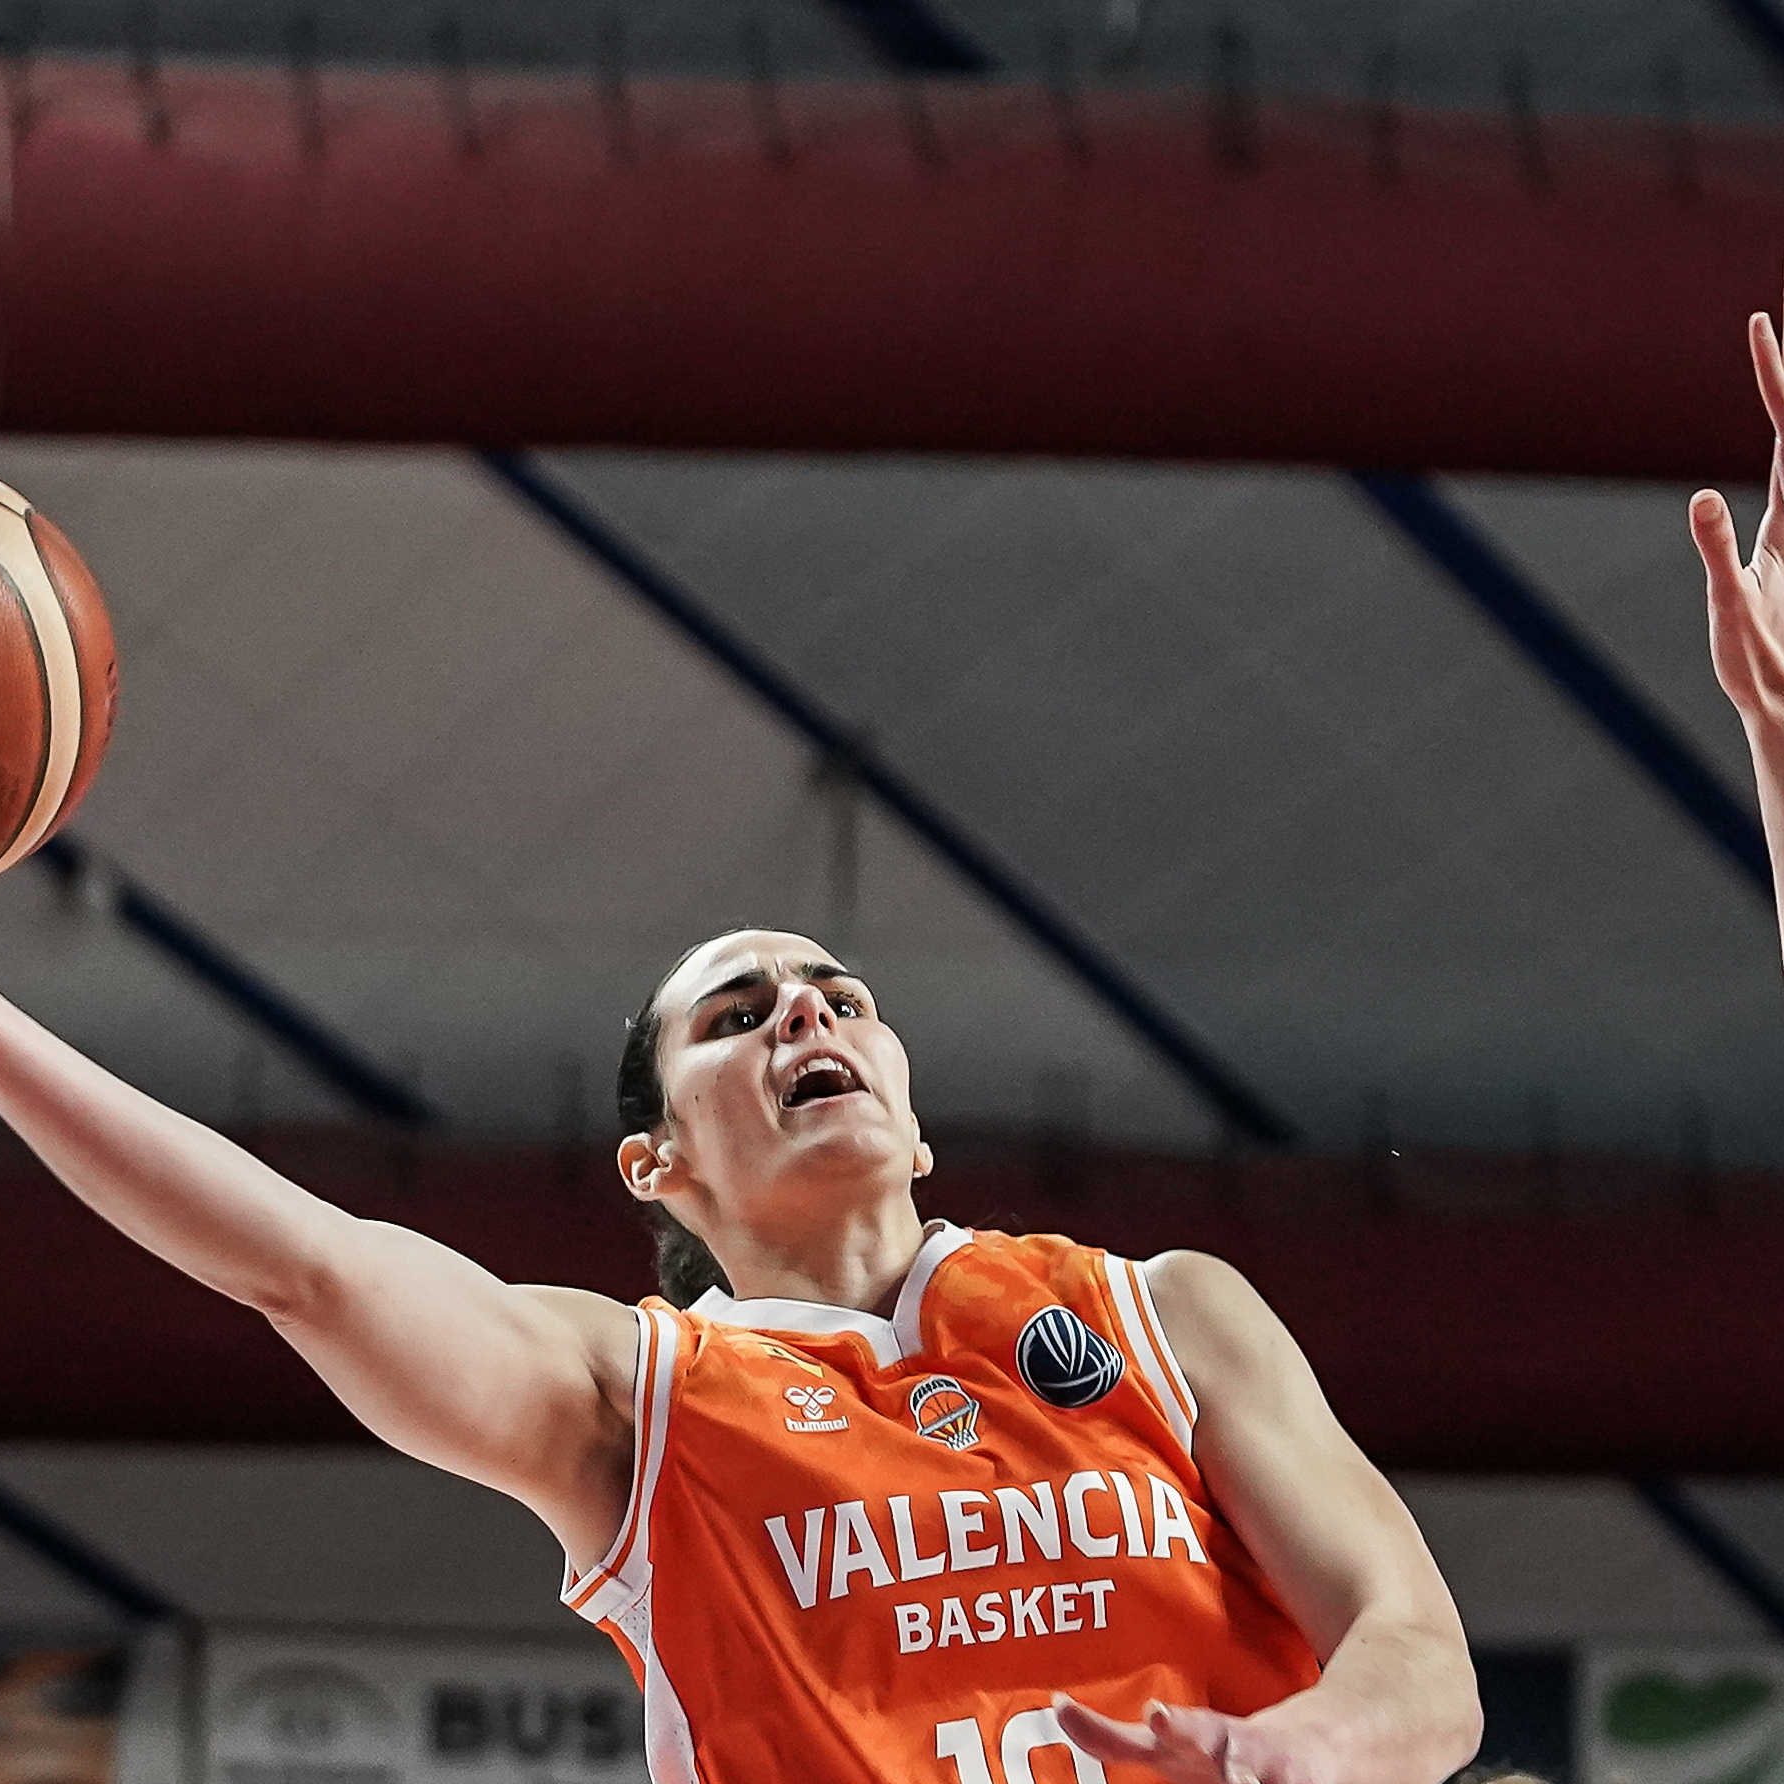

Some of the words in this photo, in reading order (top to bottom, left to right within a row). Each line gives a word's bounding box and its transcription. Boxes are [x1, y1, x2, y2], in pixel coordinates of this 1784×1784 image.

[784, 1415, 849, 1432] hummel
[764, 1470, 1208, 1610] VALENCIA
[894, 1578, 1117, 1655] BASKET
